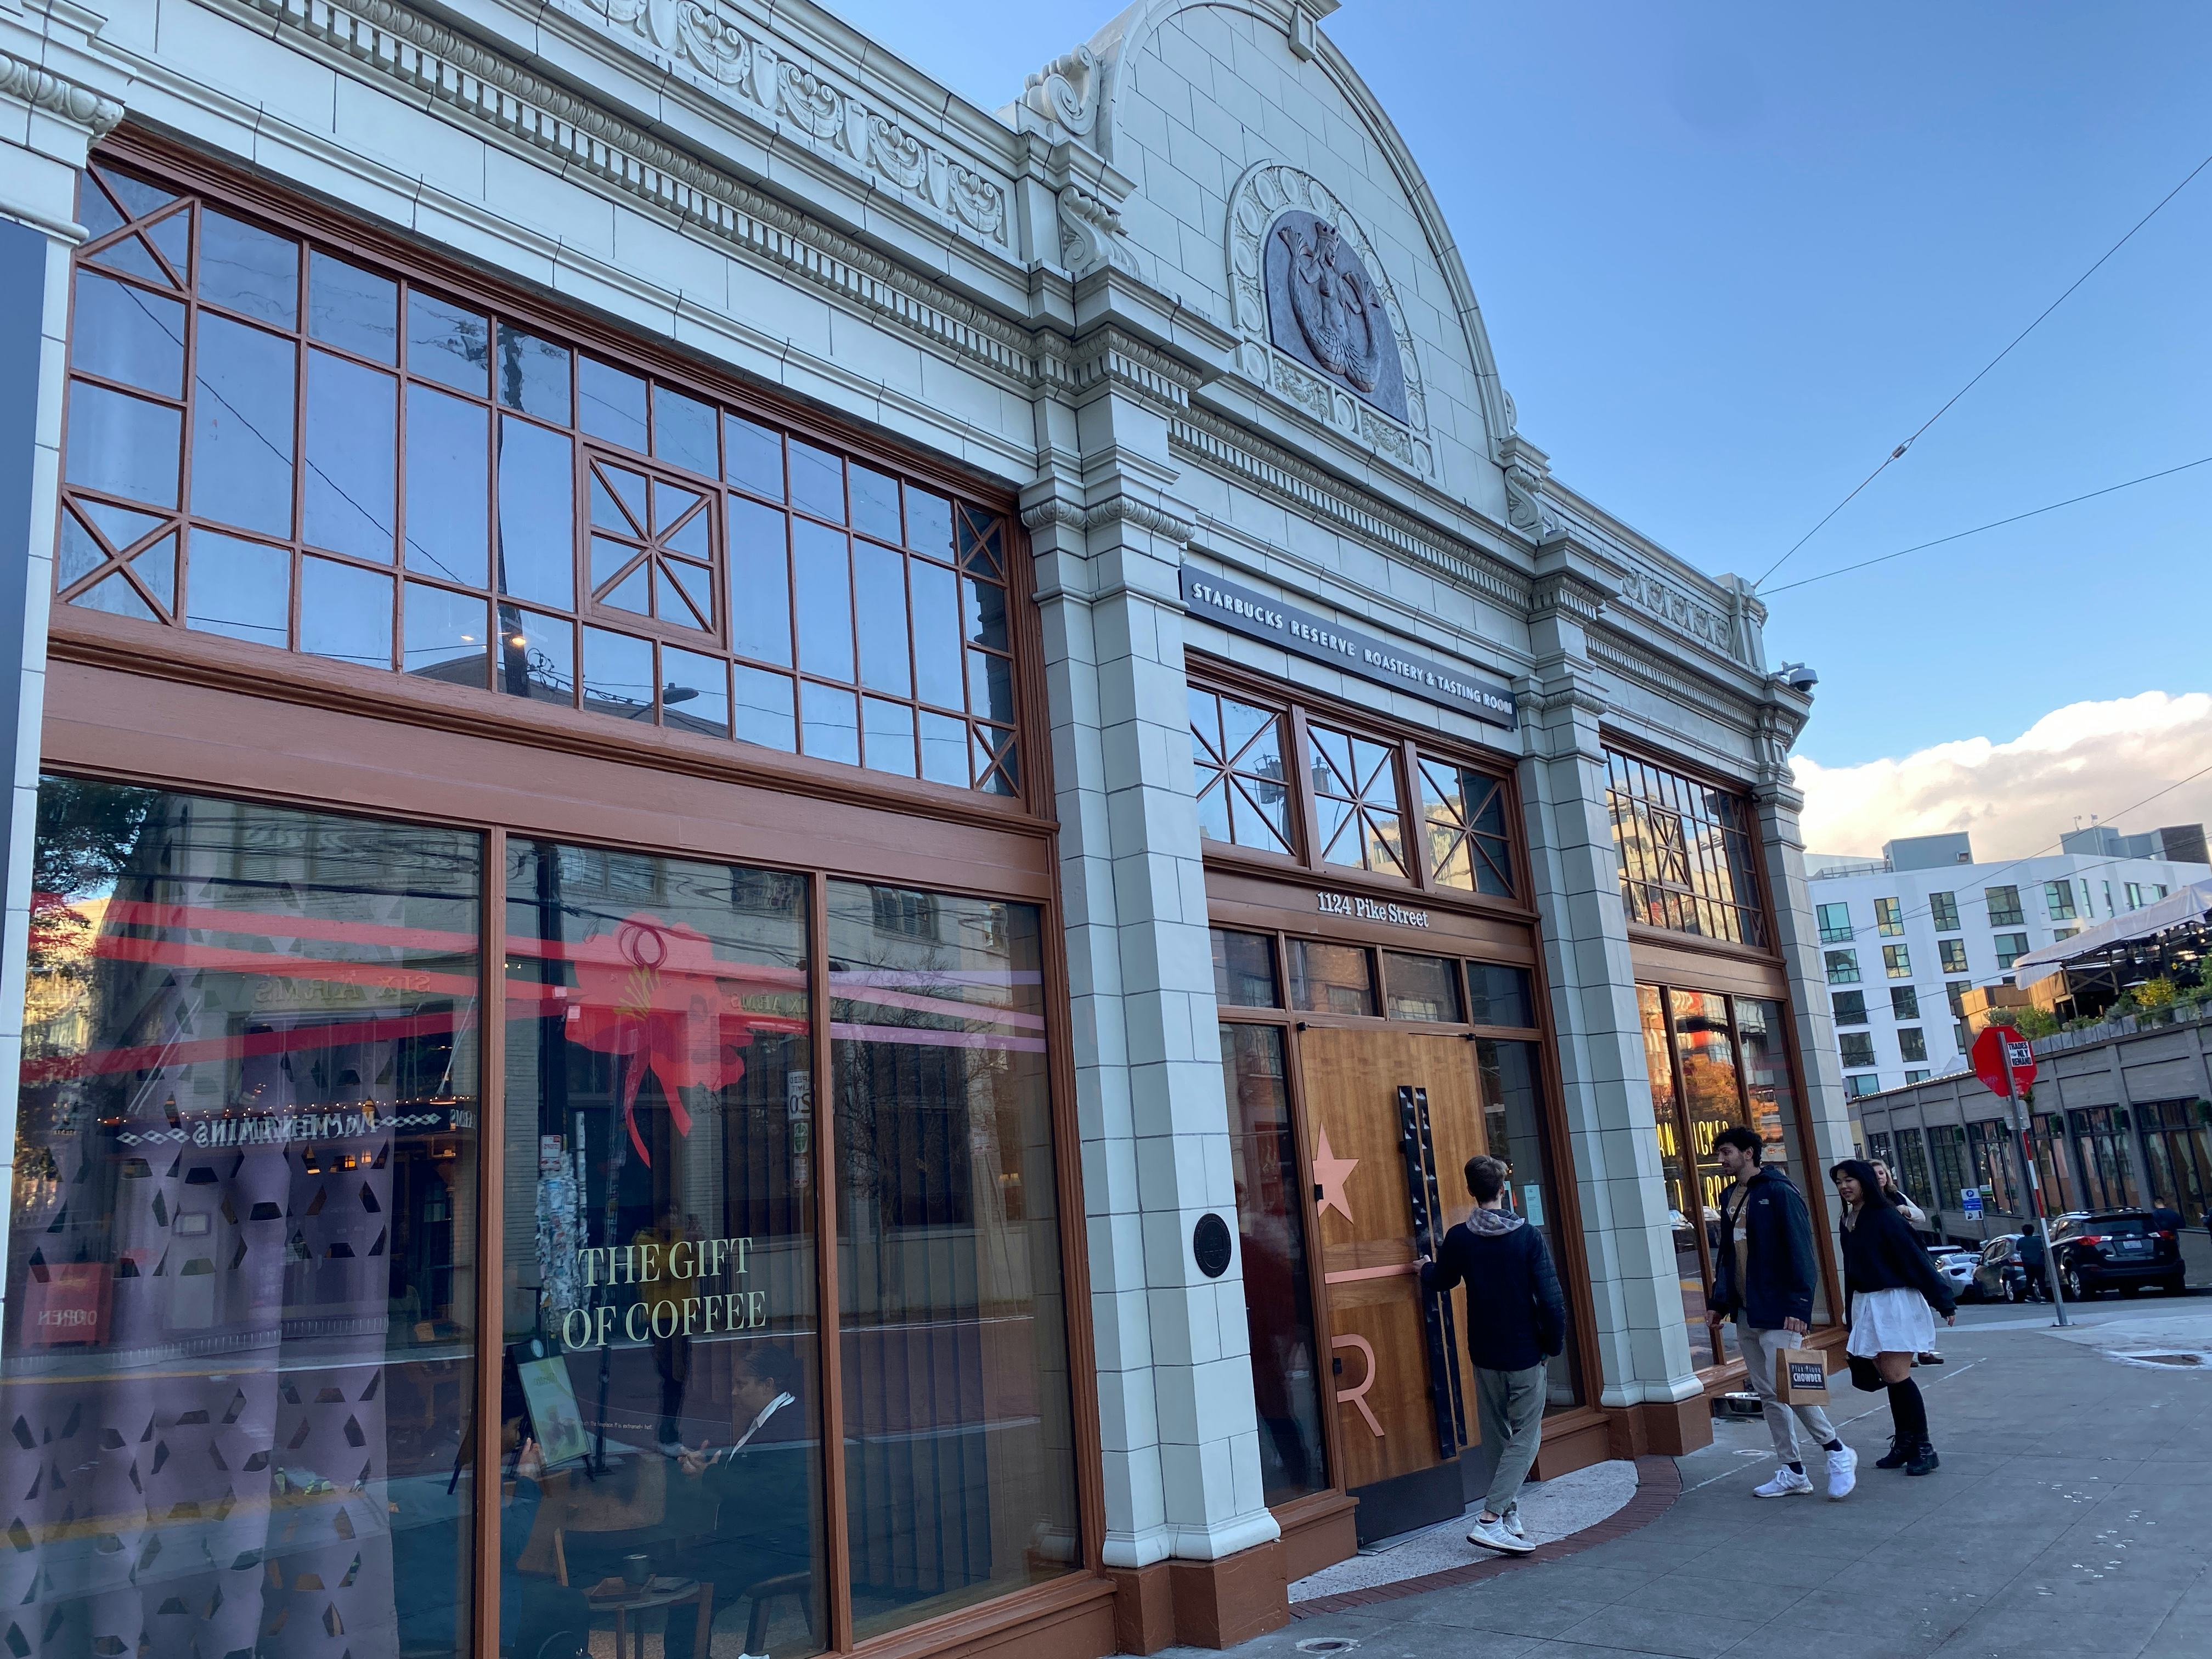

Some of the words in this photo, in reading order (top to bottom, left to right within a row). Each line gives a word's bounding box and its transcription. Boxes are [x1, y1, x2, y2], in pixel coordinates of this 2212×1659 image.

[1193, 583, 1283, 629] STARBUCKS
[1290, 620, 1356, 657] RESERVE
[1364, 648, 1423, 681] ROASTERY
[1425, 672, 1435, 686] &
[1436, 676, 1481, 703] TASTING
[1482, 693, 1513, 715] ROOM
[1317, 891, 1352, 915] 1124
[1355, 898, 1387, 921] Pike
[1388, 903, 1429, 928] Street
[578, 1244, 661, 1288] THE
[669, 1237, 753, 1279] GIFT
[562, 1306, 616, 1349] OF
[625, 1291, 766, 1342] COFFEE
[1331, 1334, 1385, 1437] R
[1793, 1373, 1822, 1383] CHOWDER
